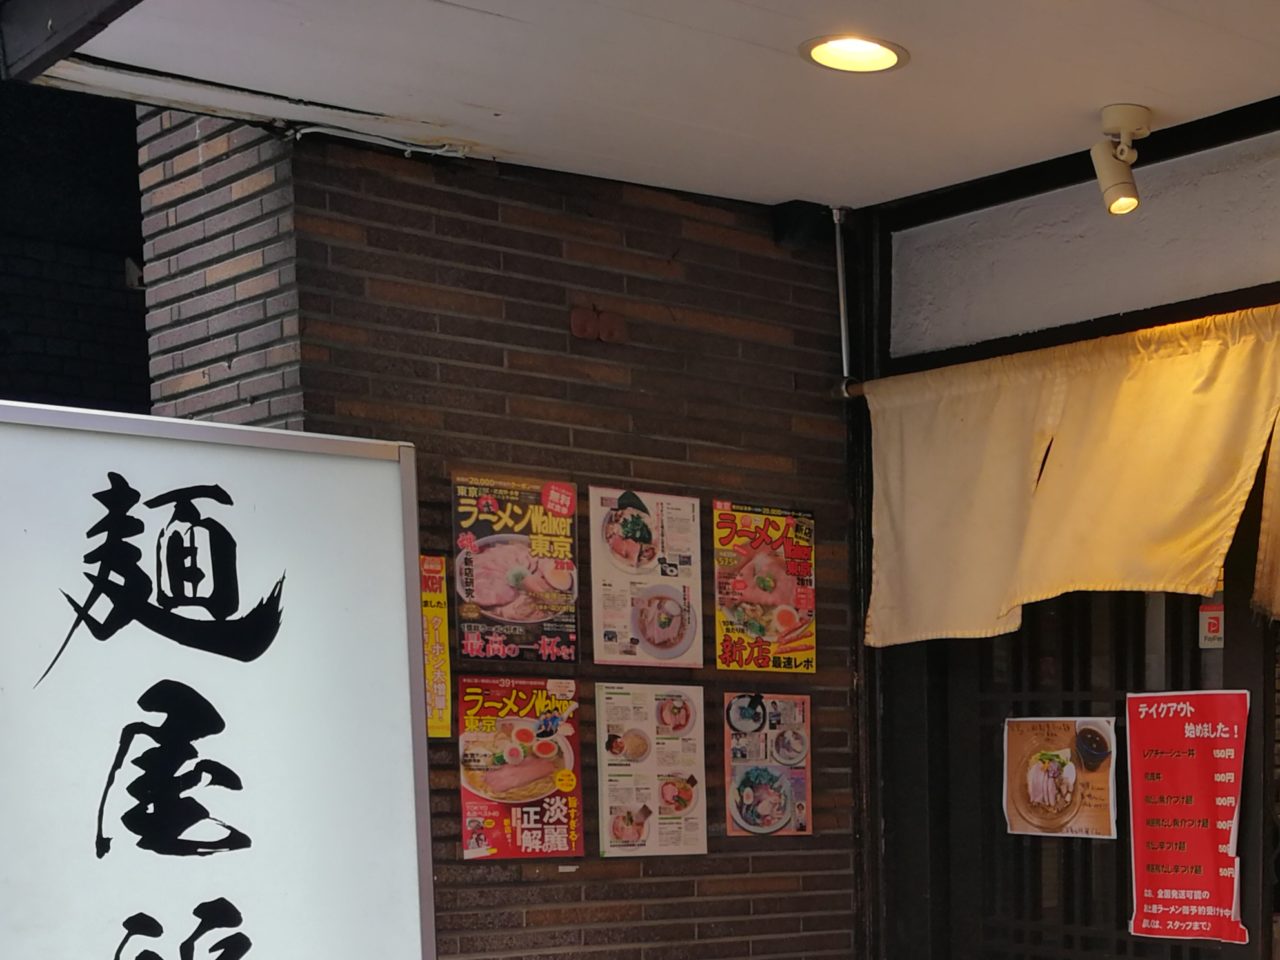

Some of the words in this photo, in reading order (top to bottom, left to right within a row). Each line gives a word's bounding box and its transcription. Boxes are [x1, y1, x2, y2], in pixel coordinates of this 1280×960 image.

[1138, 702, 1195, 719] テイクアウト
